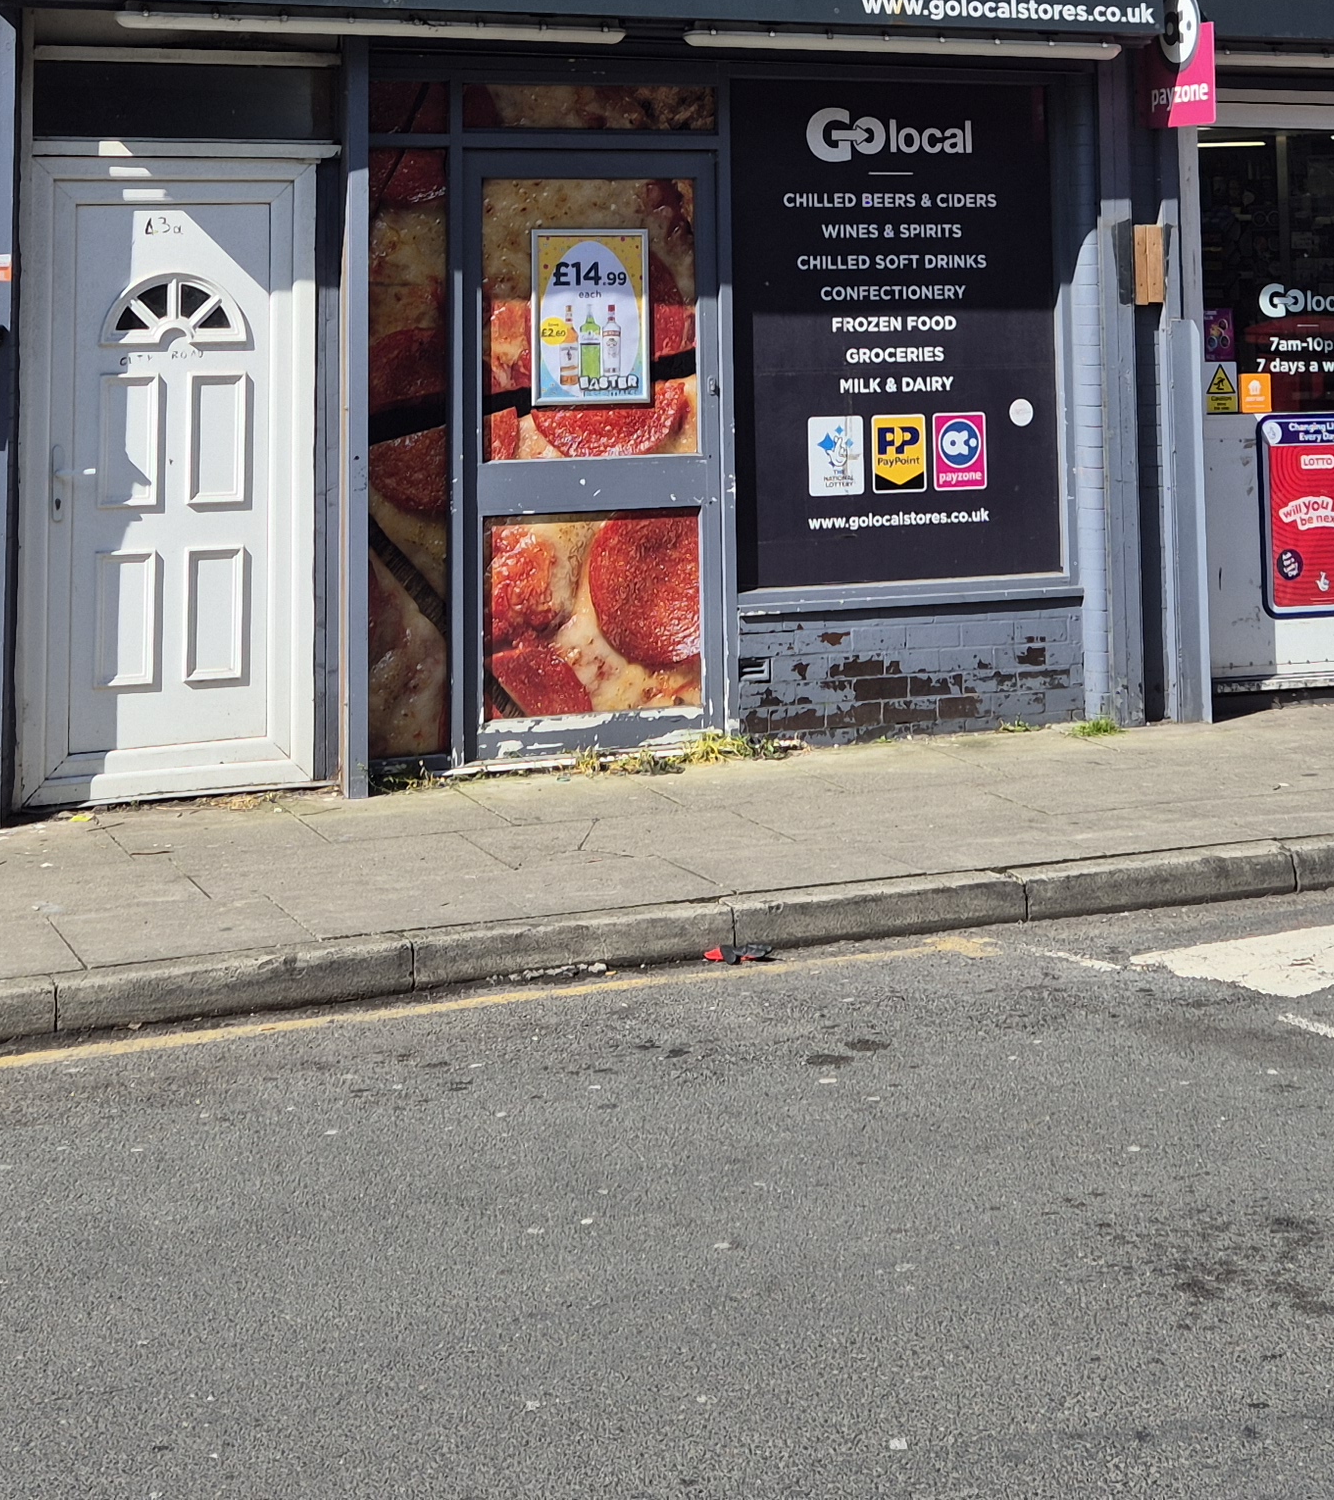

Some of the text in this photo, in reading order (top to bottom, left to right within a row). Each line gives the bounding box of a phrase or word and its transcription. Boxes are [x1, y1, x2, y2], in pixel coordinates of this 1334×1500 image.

[1151, 83, 1209, 113] payzone
[783, 193, 997, 208] CHILLED BEERS & CIDERS
[822, 224, 962, 239] WINES & SPIRITS
[797, 254, 987, 270] CHILLED SOFT DRINKS
[553, 261, 627, 287] £14.99
[578, 290, 602, 299] each
[820, 285, 966, 301] CONFECTIONERY
[832, 315, 956, 333] FROZEN FOOD
[846, 347, 944, 363] GROCERIES
[1256, 358, 1266, 373] 7
[1270, 358, 1306, 375] days
[1309, 361, 1319, 373] a
[579, 374, 639, 391] EASTER
[840, 376, 954, 393] MILK & DAIRY
[1288, 422, 1326, 433] Changing
[1299, 432, 1321, 442] Every
[878, 456, 920, 468] PayPoint
[1303, 457, 1333, 466] LOTTO
[939, 471, 982, 484] payzone
[1283, 499, 1330, 519] will you
[809, 508, 989, 530] www.golocalstores.co.uk
[1299, 513, 1313, 526] be
